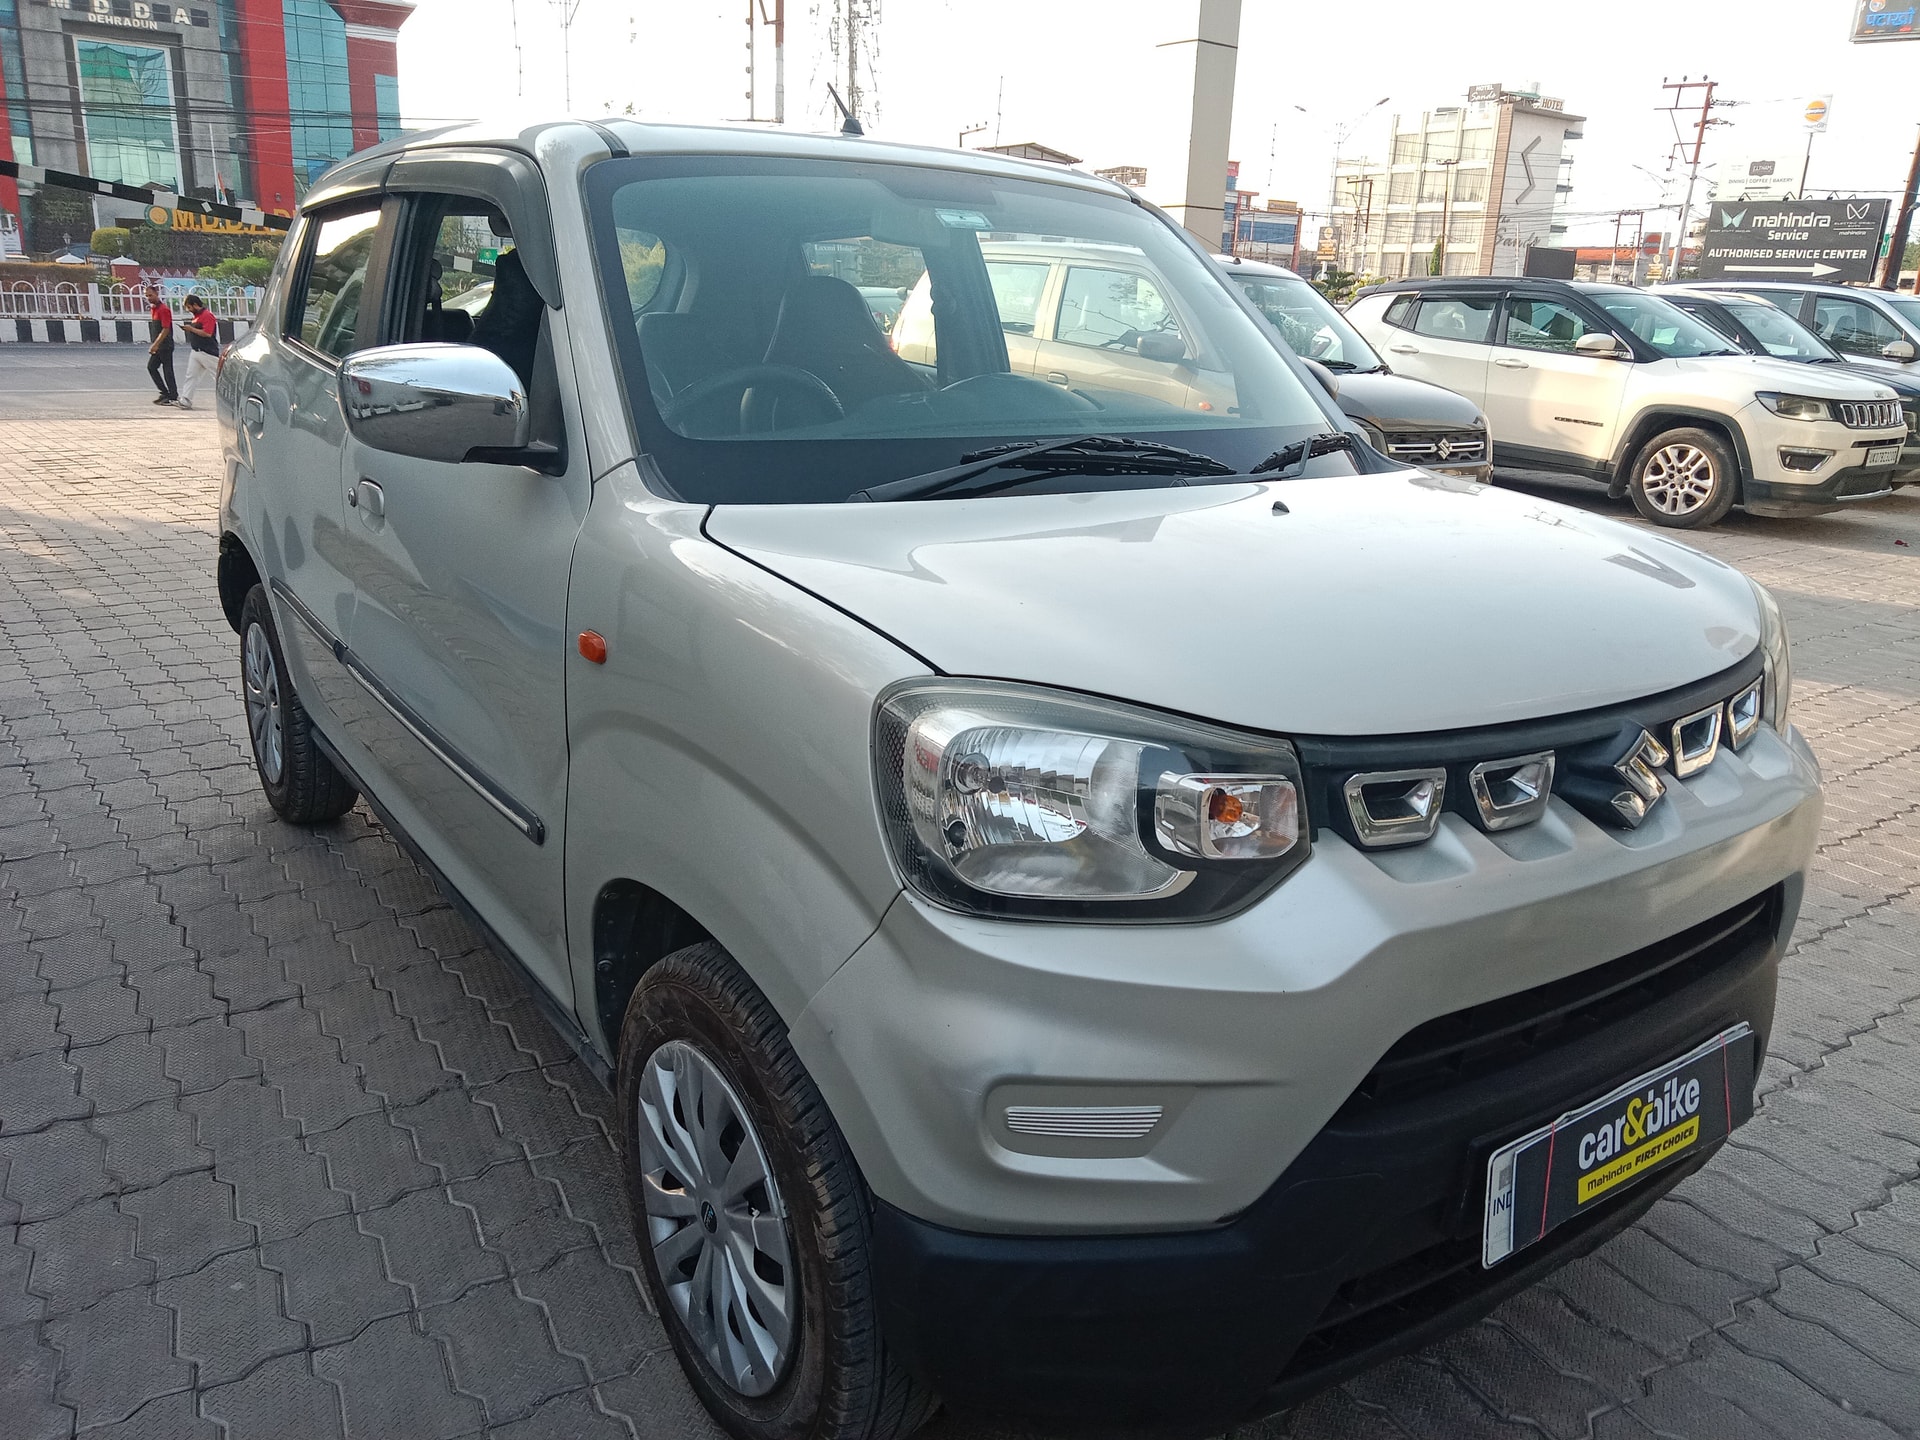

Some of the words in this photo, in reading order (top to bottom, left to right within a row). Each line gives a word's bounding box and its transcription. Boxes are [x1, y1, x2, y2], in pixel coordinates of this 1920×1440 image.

[88, 13, 158, 30] DEHRADUN
[1542, 99, 1564, 111] HOTEL
[1752, 212, 1831, 228] mahindra
[1767, 230, 1809, 241] Service
[1708, 248, 1774, 259] AUTHORISED
[1775, 249, 1821, 259] SERVICE
[1822, 249, 1867, 260] CENTER
[1587, 1162, 1632, 1192] Mahindra
[1635, 1144, 1661, 1167] FIRST
[1662, 1125, 1695, 1151] CHOICE
